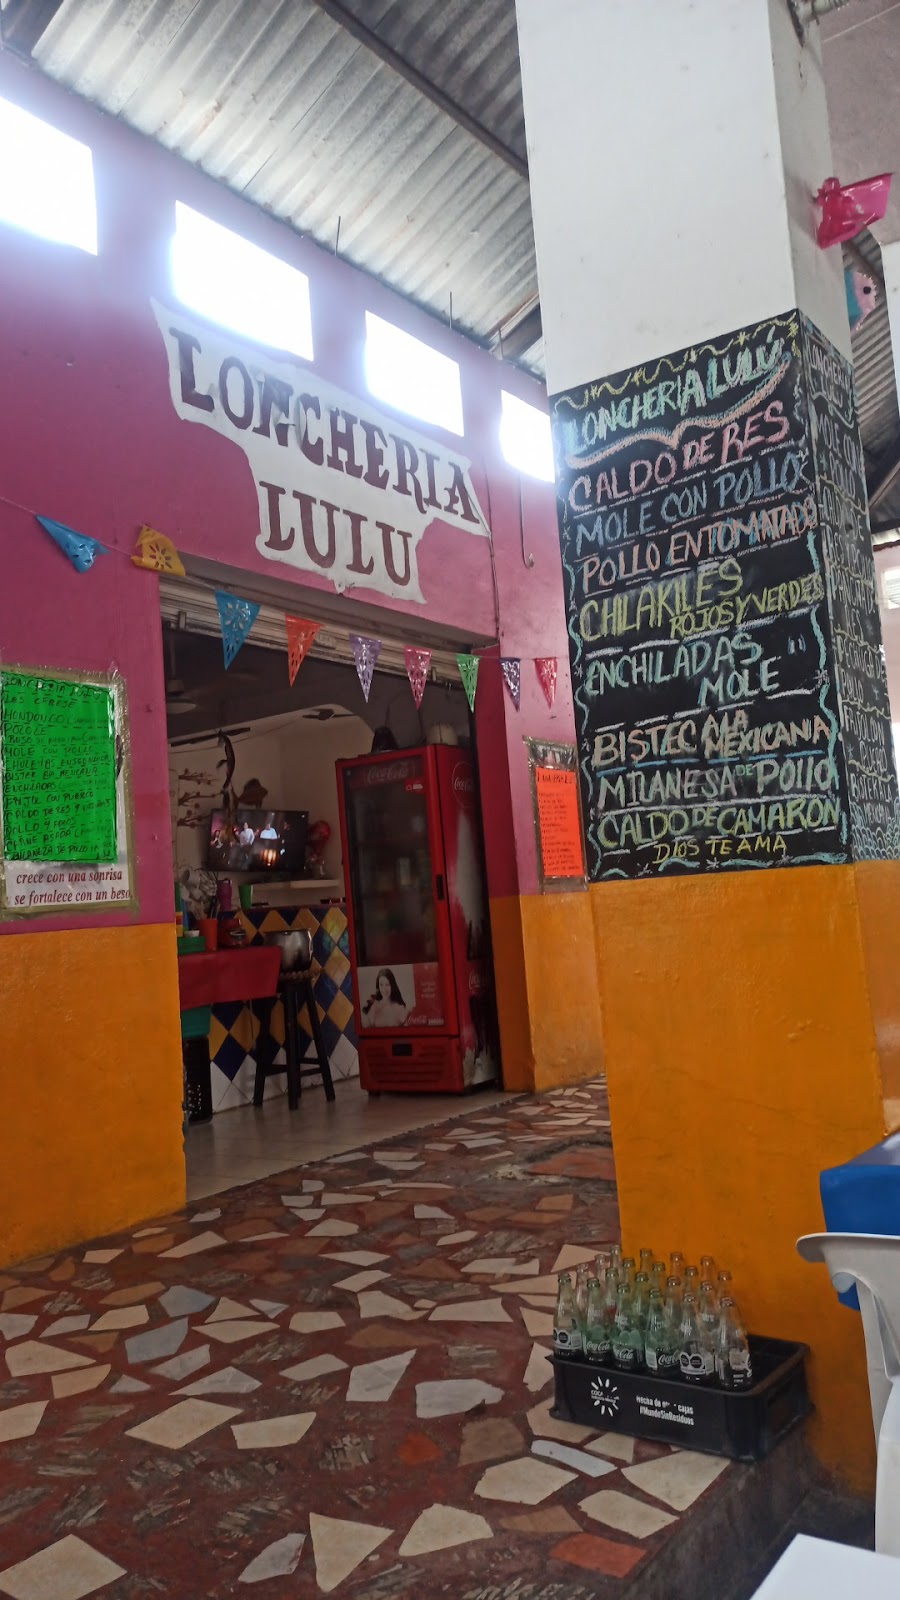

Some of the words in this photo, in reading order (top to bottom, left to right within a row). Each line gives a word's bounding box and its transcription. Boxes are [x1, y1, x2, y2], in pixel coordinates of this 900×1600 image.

[169, 327, 480, 524] LONCHERIA
[565, 368, 707, 453] LONCHERIA
[569, 452, 677, 512] CALDO
[683, 431, 715, 470] DE
[721, 400, 790, 465] RES
[258, 480, 413, 586] LULU
[576, 500, 656, 556] MOLE
[661, 479, 707, 524] CON
[714, 451, 801, 507] POLLO
[583, 540, 660, 594] POLLO
[668, 493, 818, 566] ENTOMATADO
[580, 558, 743, 642] CHILAKILES
[670, 602, 735, 639] ROJOS
[733, 593, 751, 623] Y
[751, 572, 824, 614] VERDES
[585, 632, 763, 696] ENCHILADAS
[697, 656, 781, 706] MOLE
[592, 719, 697, 770] BISTEC
[703, 715, 831, 759] MEXICANA
[598, 766, 737, 810] MILANESA
[736, 764, 754, 777] DE
[753, 756, 834, 794] POLLO
[599, 809, 689, 848] CALDO
[692, 806, 717, 828] DE
[716, 797, 839, 837] CAMARON
[653, 839, 699, 865] DIOS
[705, 838, 732, 855] TE
[737, 834, 788, 854] AMA
[14, 893, 27, 905] se
[28, 890, 72, 906] fortalece
[75, 892, 92, 902] con
[96, 891, 108, 900] un
[16, 872, 43, 884] crece
[46, 873, 65, 883] con
[68, 872, 86, 882] una
[89, 868, 122, 882] sonrisa
